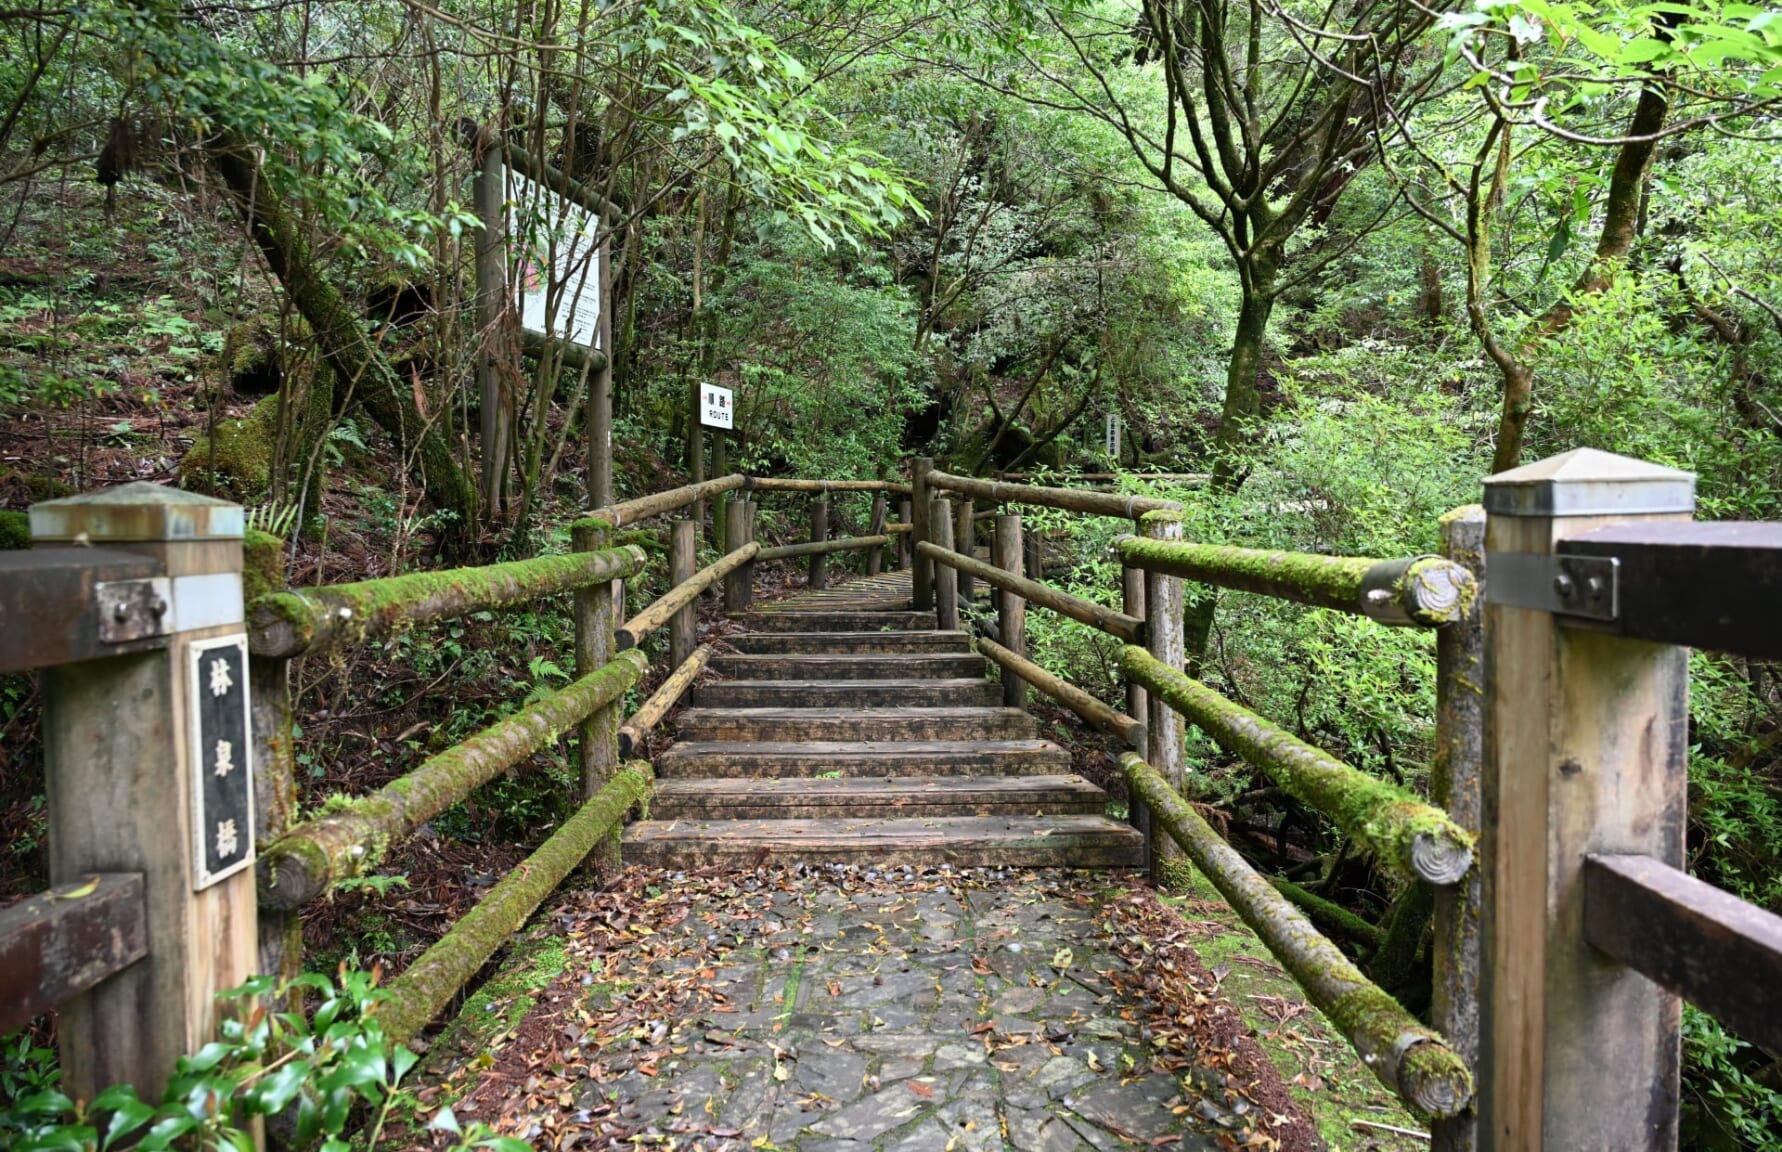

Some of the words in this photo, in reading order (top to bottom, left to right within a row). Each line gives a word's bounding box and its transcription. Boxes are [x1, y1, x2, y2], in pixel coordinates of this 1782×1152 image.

[710, 410, 728, 421] ROUTE
[210, 658, 237, 858] 林泉橋
